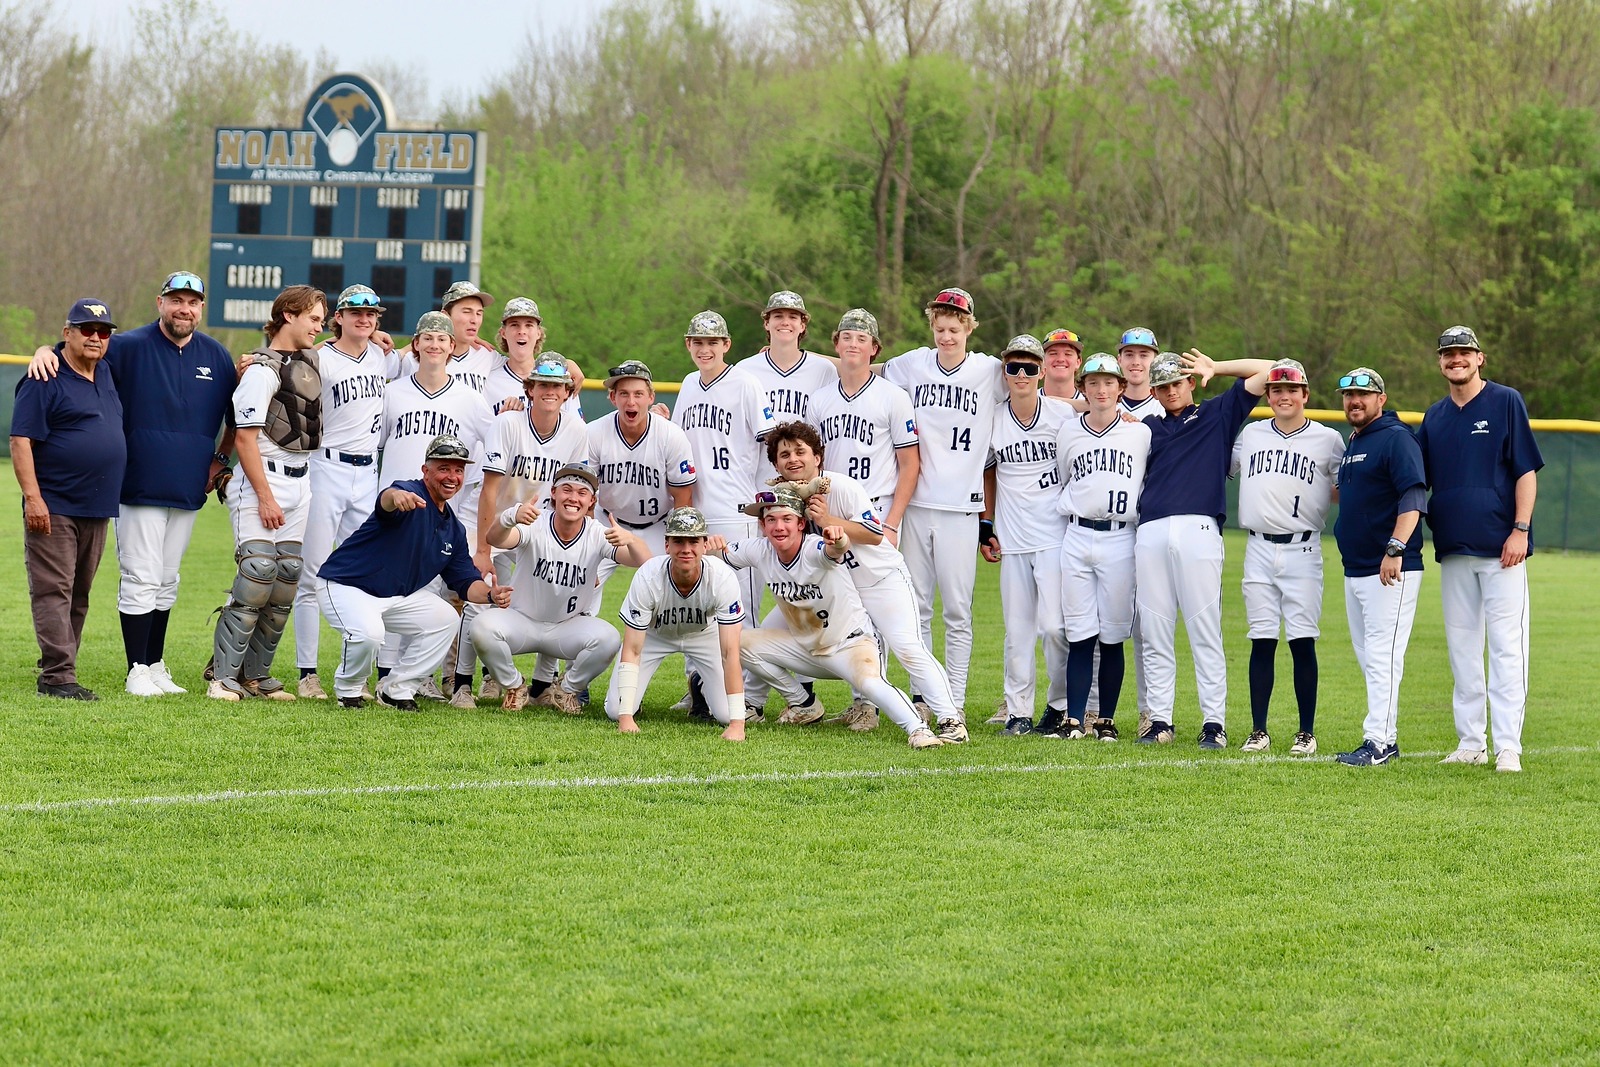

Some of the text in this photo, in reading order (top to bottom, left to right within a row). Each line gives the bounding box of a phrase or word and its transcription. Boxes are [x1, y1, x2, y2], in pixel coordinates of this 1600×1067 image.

[216, 130, 474, 173] NOAH FIELD
[251, 169, 265, 180] AT
[377, 187, 420, 208] STRIKE
[444, 189, 469, 209] OUT
[376, 240, 403, 260] HITS
[227, 264, 282, 288] GUESTS
[223, 298, 275, 322] MUSTAN
[765, 388, 809, 419] STANG
[911, 383, 978, 416] MUSTANGS
[681, 403, 732, 436] MUSTANGS
[819, 413, 875, 446] MUSTANGS
[951, 426, 971, 452] 14
[712, 446, 730, 470] 16
[848, 457, 871, 480] 28
[1073, 448, 1133, 482] MUSTANGS
[1248, 449, 1316, 485] MUSTANGS
[597, 461, 660, 489] MUSTANGS
[638, 497, 659, 517] 13
[1107, 490, 1128, 515] 18
[1292, 495, 1300, 518] 1
[532, 557, 587, 588] MUSTANGS
[566, 595, 578, 614] 6
